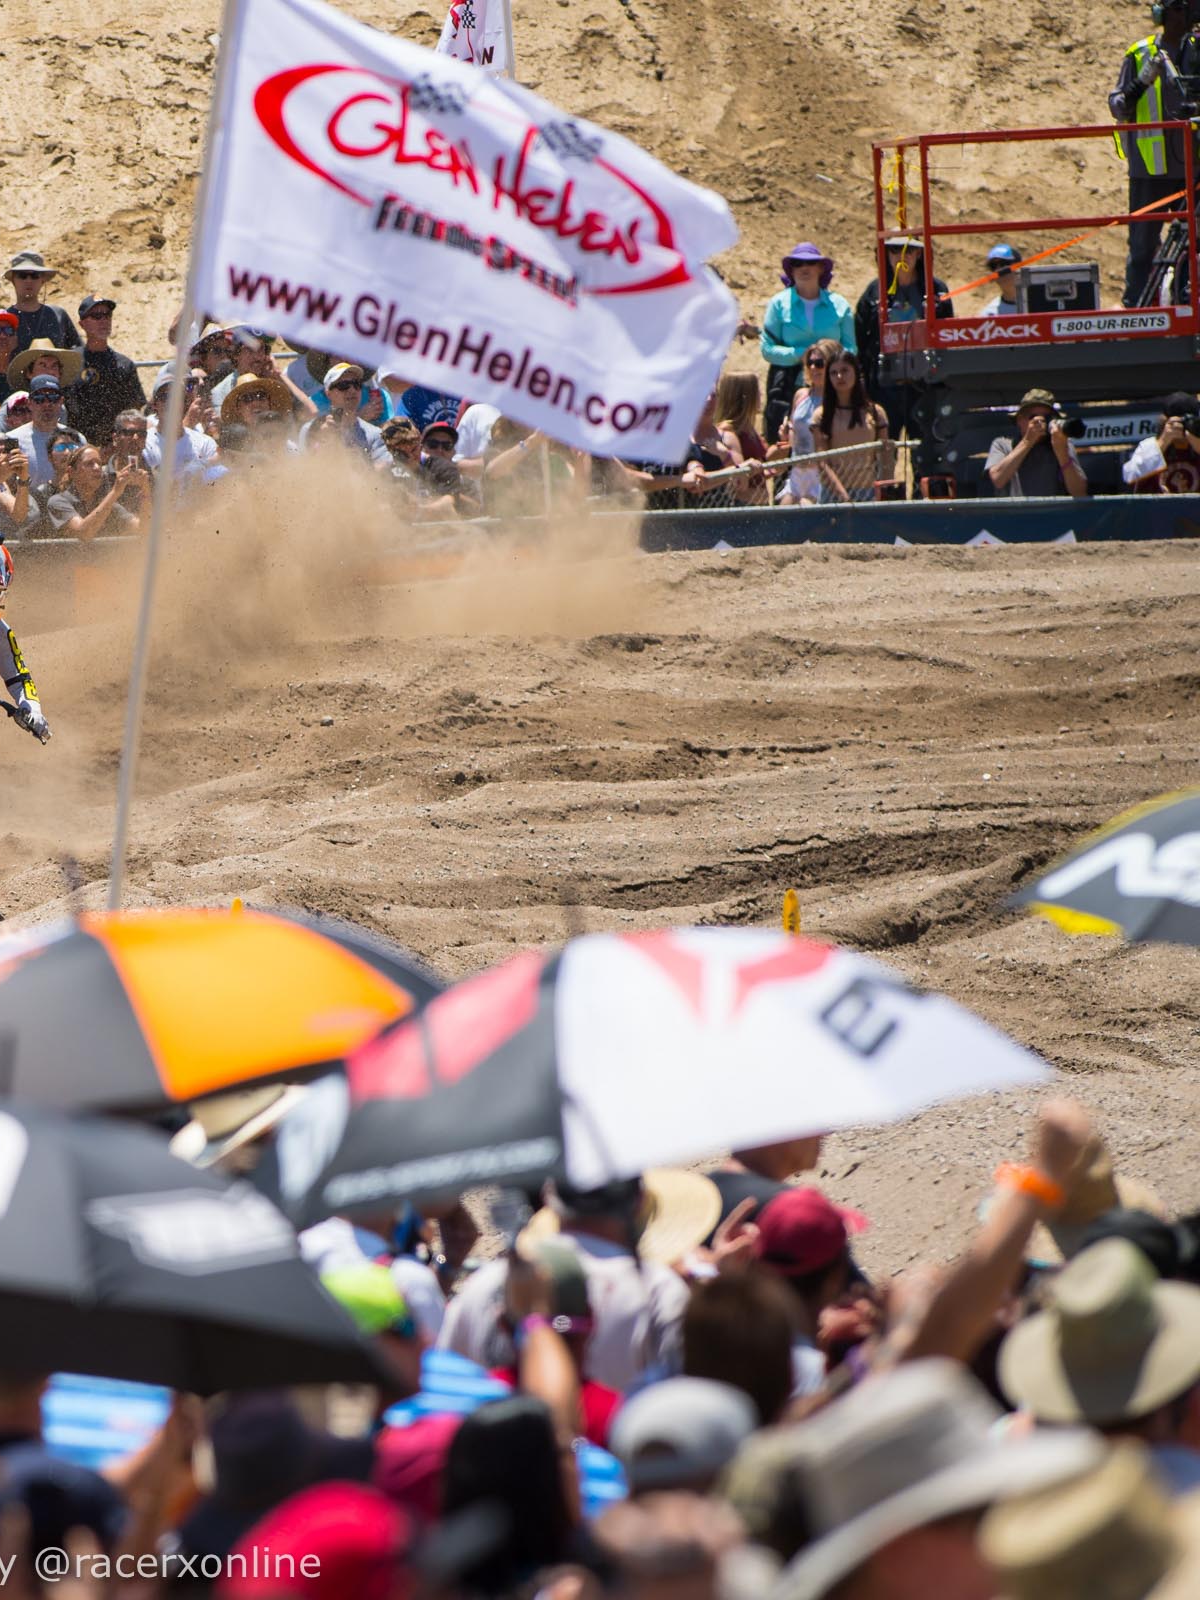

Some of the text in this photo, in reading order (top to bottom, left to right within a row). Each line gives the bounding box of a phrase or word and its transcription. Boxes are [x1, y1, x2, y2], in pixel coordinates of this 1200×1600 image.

[326, 80, 480, 195] GLEN
[228, 264, 671, 435] www.GlenHelen.com
[938, 314, 1166, 343] SKYJACK 1-800-UR-RENTS
[1084, 420, 1134, 440] nited
